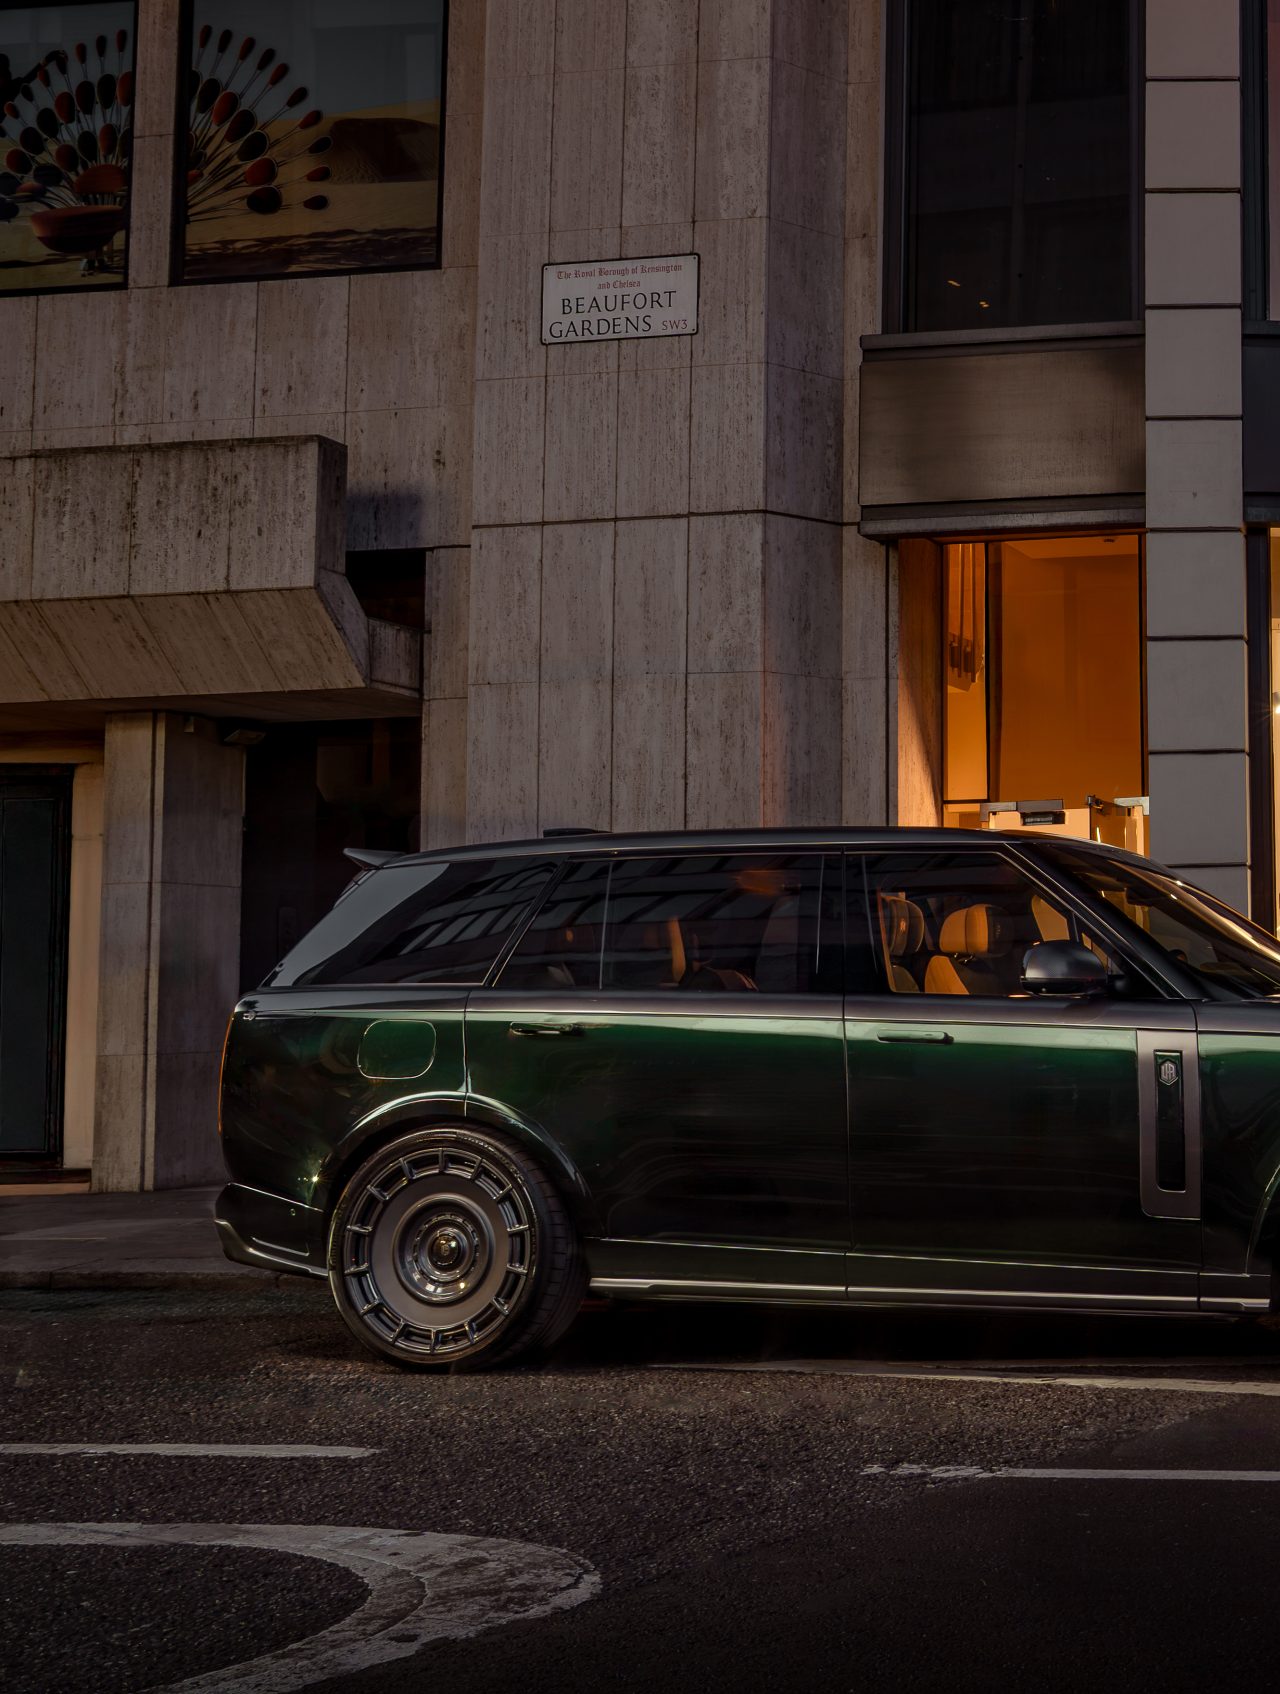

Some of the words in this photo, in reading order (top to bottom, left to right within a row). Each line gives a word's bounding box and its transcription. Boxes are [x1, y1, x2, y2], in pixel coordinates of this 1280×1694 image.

[557, 270, 571, 280] The
[574, 269, 596, 279] Royal
[598, 267, 630, 277] Borough
[631, 266, 638, 275] of
[640, 264, 683, 274] Kensington
[597, 281, 611, 290] and
[612, 280, 641, 289] Chelsea
[562, 290, 677, 315] BEAUFORT
[549, 315, 652, 338] GARDENS
[662, 319, 688, 331] SW3
